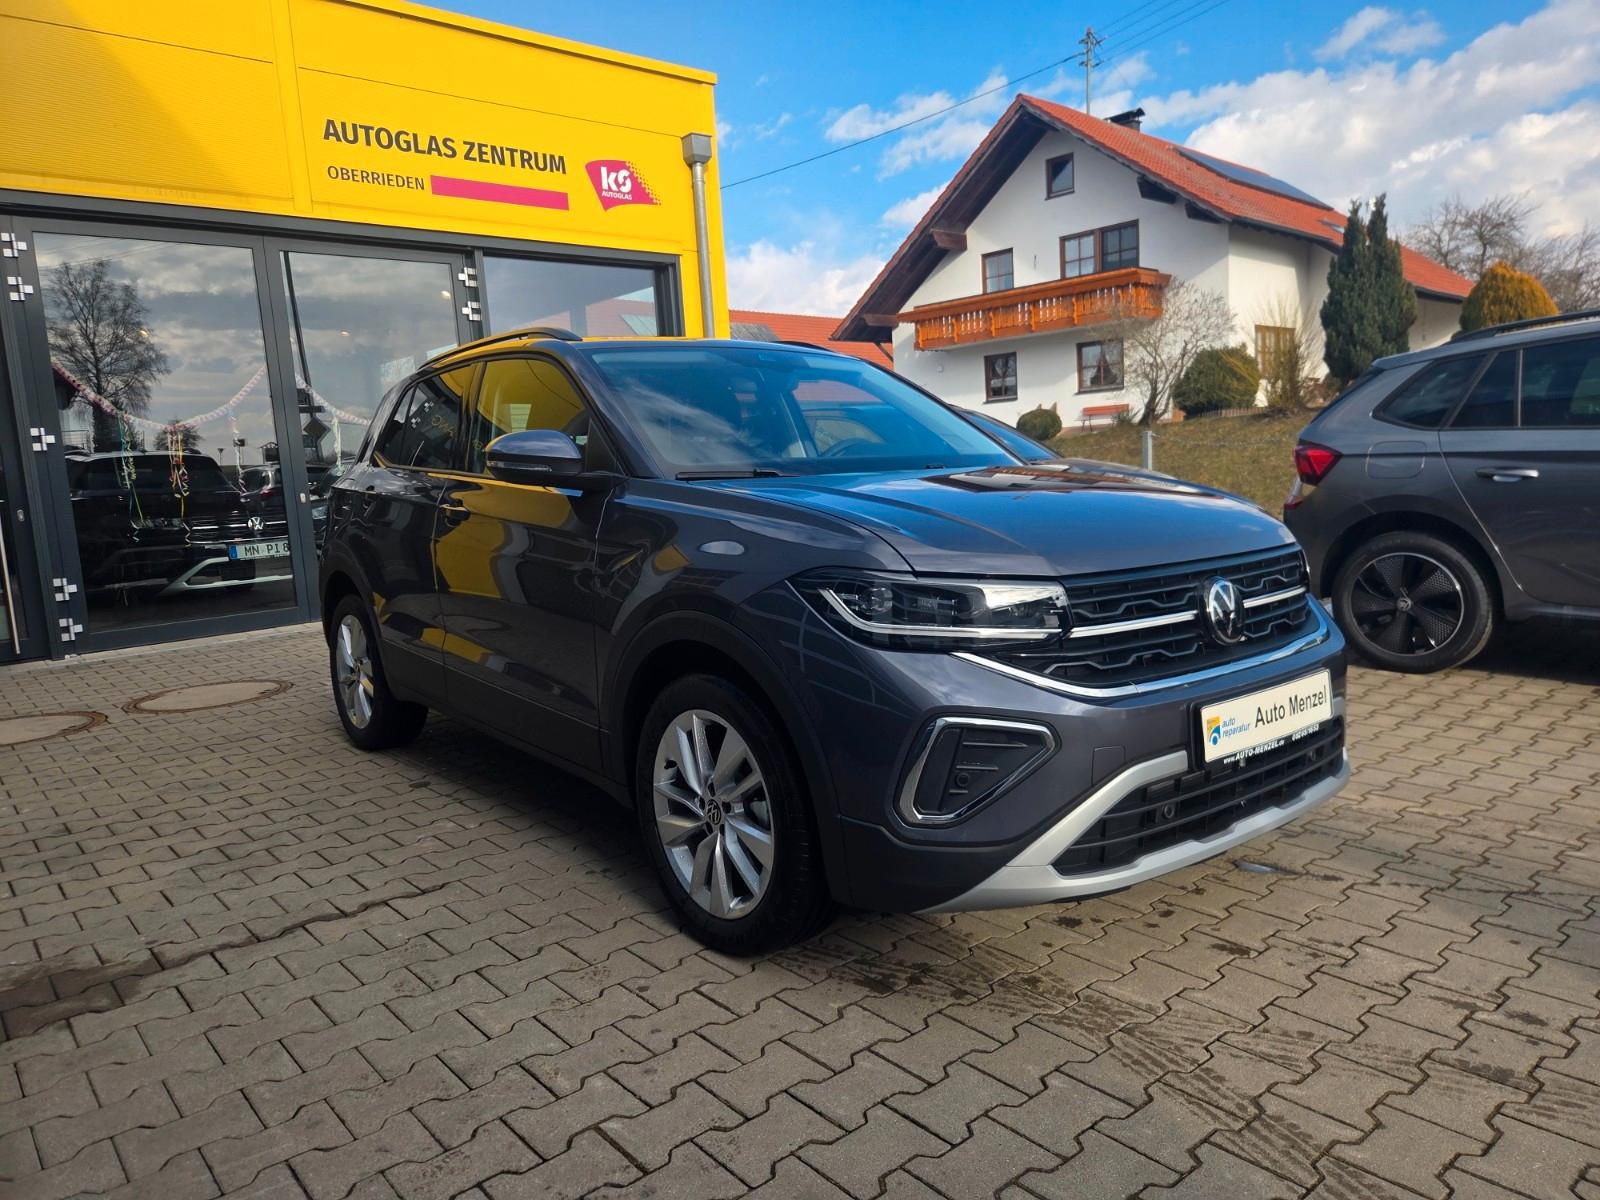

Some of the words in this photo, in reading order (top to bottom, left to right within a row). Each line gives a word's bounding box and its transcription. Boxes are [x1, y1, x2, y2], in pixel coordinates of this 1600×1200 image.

[323, 118, 457, 158] AUTOGLAS
[462, 140, 567, 175] ZENTRUM
[327, 165, 425, 190] OBERRIEDEN
[601, 190, 633, 201] AUTOGLAS
[244, 545, 260, 557] MN
[1254, 704, 1286, 728] Auto
[1288, 684, 1327, 716] Menzel
[1221, 717, 1236, 728] auto
[1222, 722, 1251, 738] reparatur
